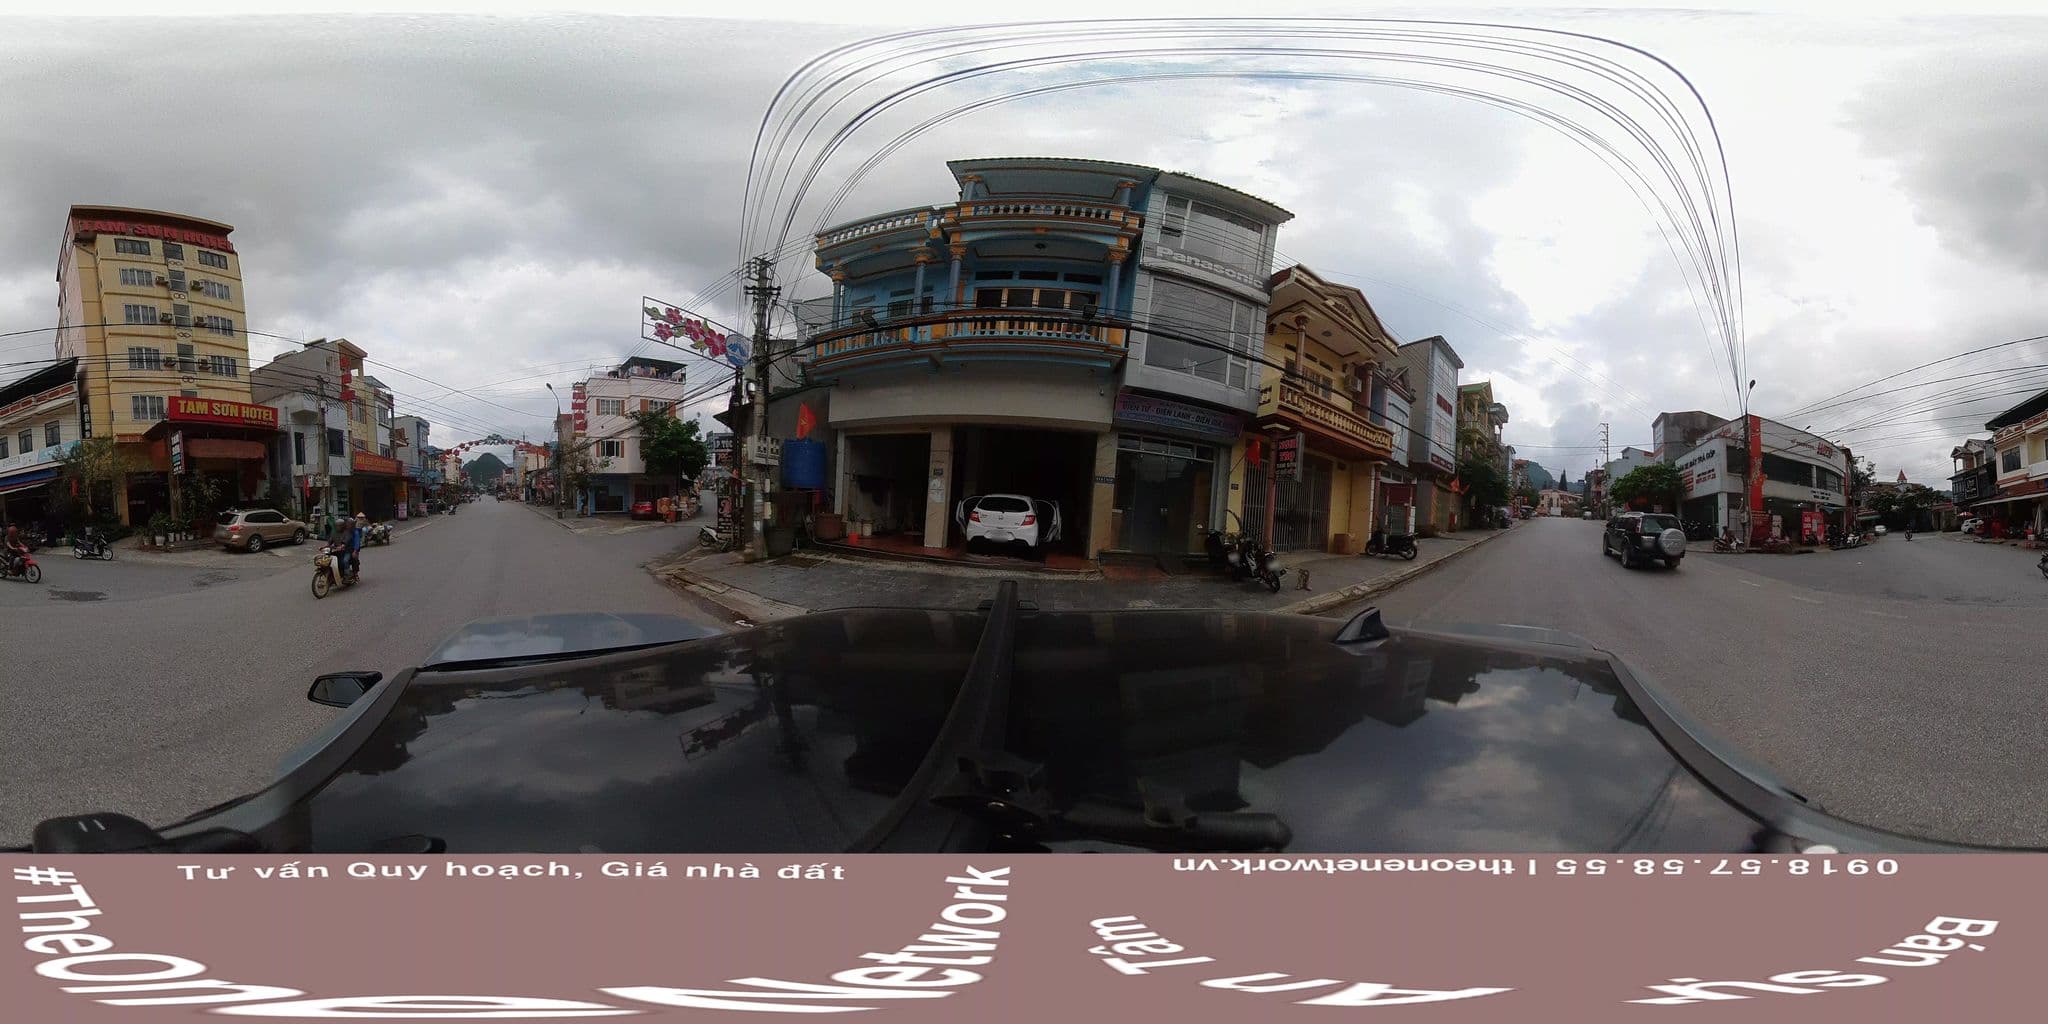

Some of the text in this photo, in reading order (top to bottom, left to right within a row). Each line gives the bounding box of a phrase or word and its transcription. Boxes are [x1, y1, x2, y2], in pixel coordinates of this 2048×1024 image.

[80, 220, 128, 234] TAM
[182, 230, 234, 253] HOTEL
[1156, 245, 1264, 289] Panasonic
[178, 400, 274, 421] TAM SƠN HOTEL
